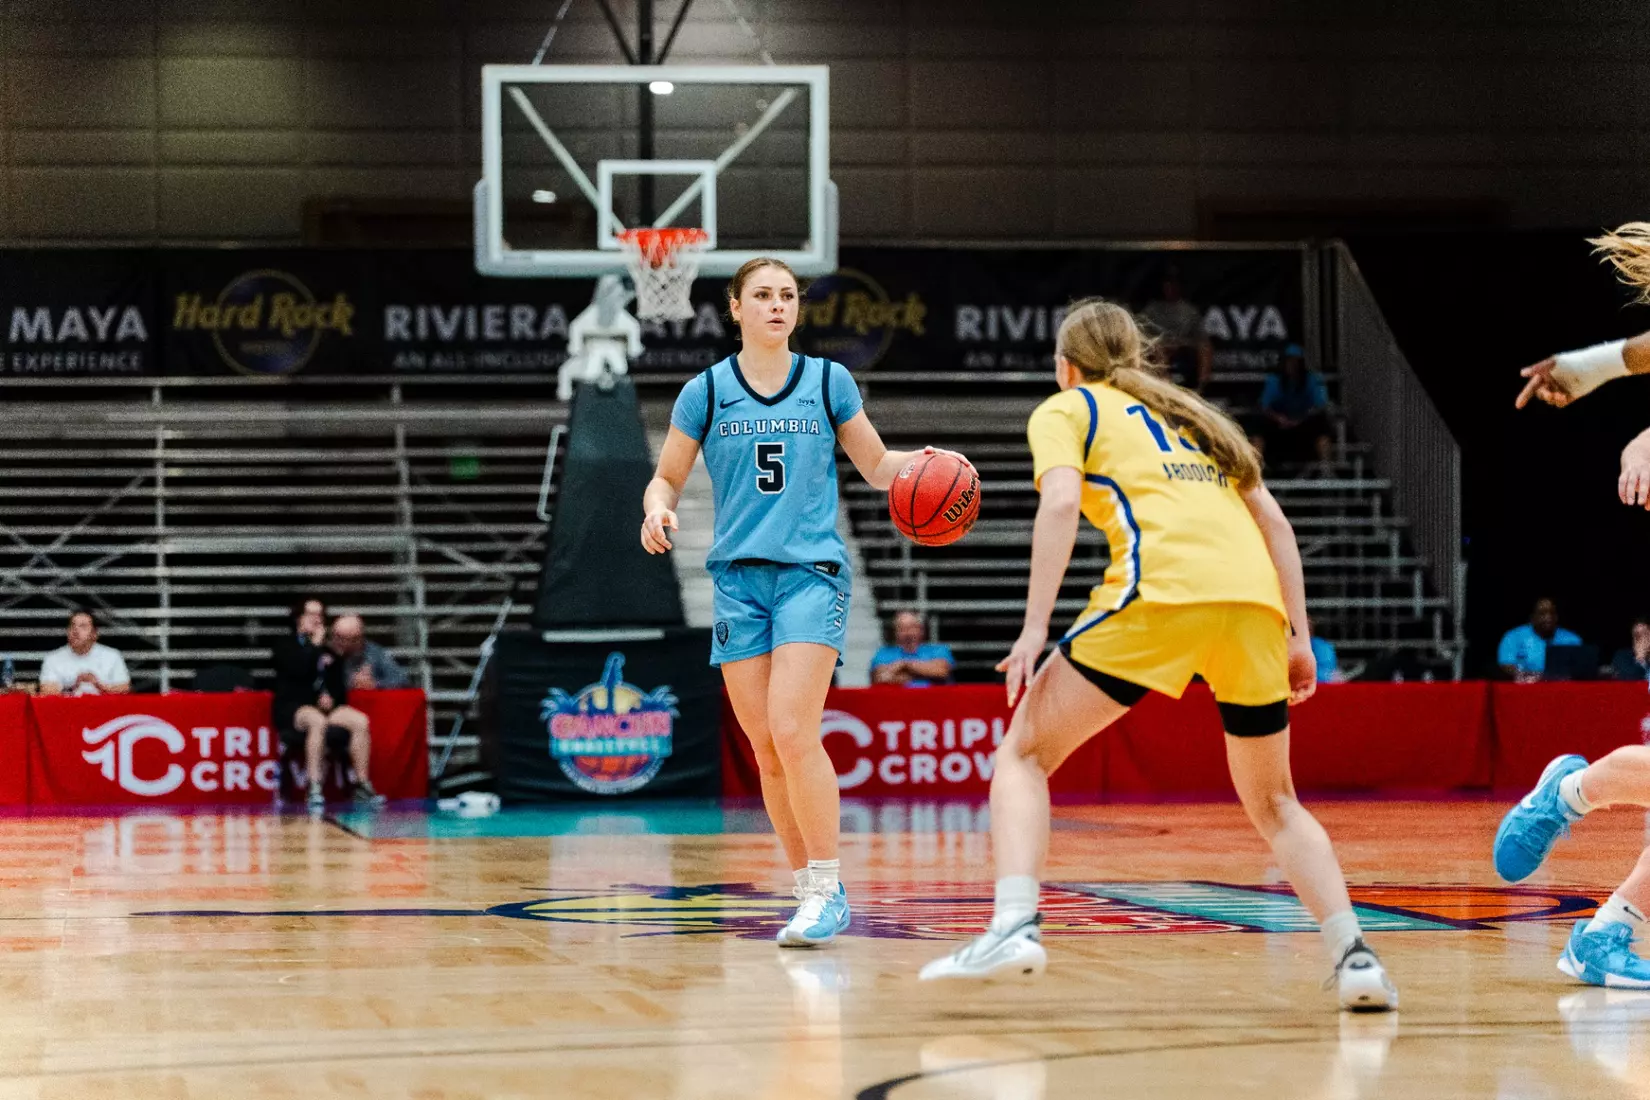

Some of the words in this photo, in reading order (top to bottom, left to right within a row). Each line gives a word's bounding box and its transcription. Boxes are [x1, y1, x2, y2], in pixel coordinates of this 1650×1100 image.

[9, 306, 149, 343] MAYA
[173, 292, 263, 331] Hard
[268, 292, 355, 337] Rock
[383, 304, 569, 341] RIVIERA
[841, 291, 928, 337] Rock
[955, 304, 1068, 341] RIVI
[1204, 304, 1288, 341] AYA
[12, 352, 142, 372] EXPERIENCE
[719, 419, 820, 437] COLUMBIA
[755, 441, 786, 495] 5
[833, 591, 846, 630] LIO
[191, 726, 287, 758] TRI
[878, 719, 1004, 750] TRIPL
[878, 752, 997, 783] CRO
